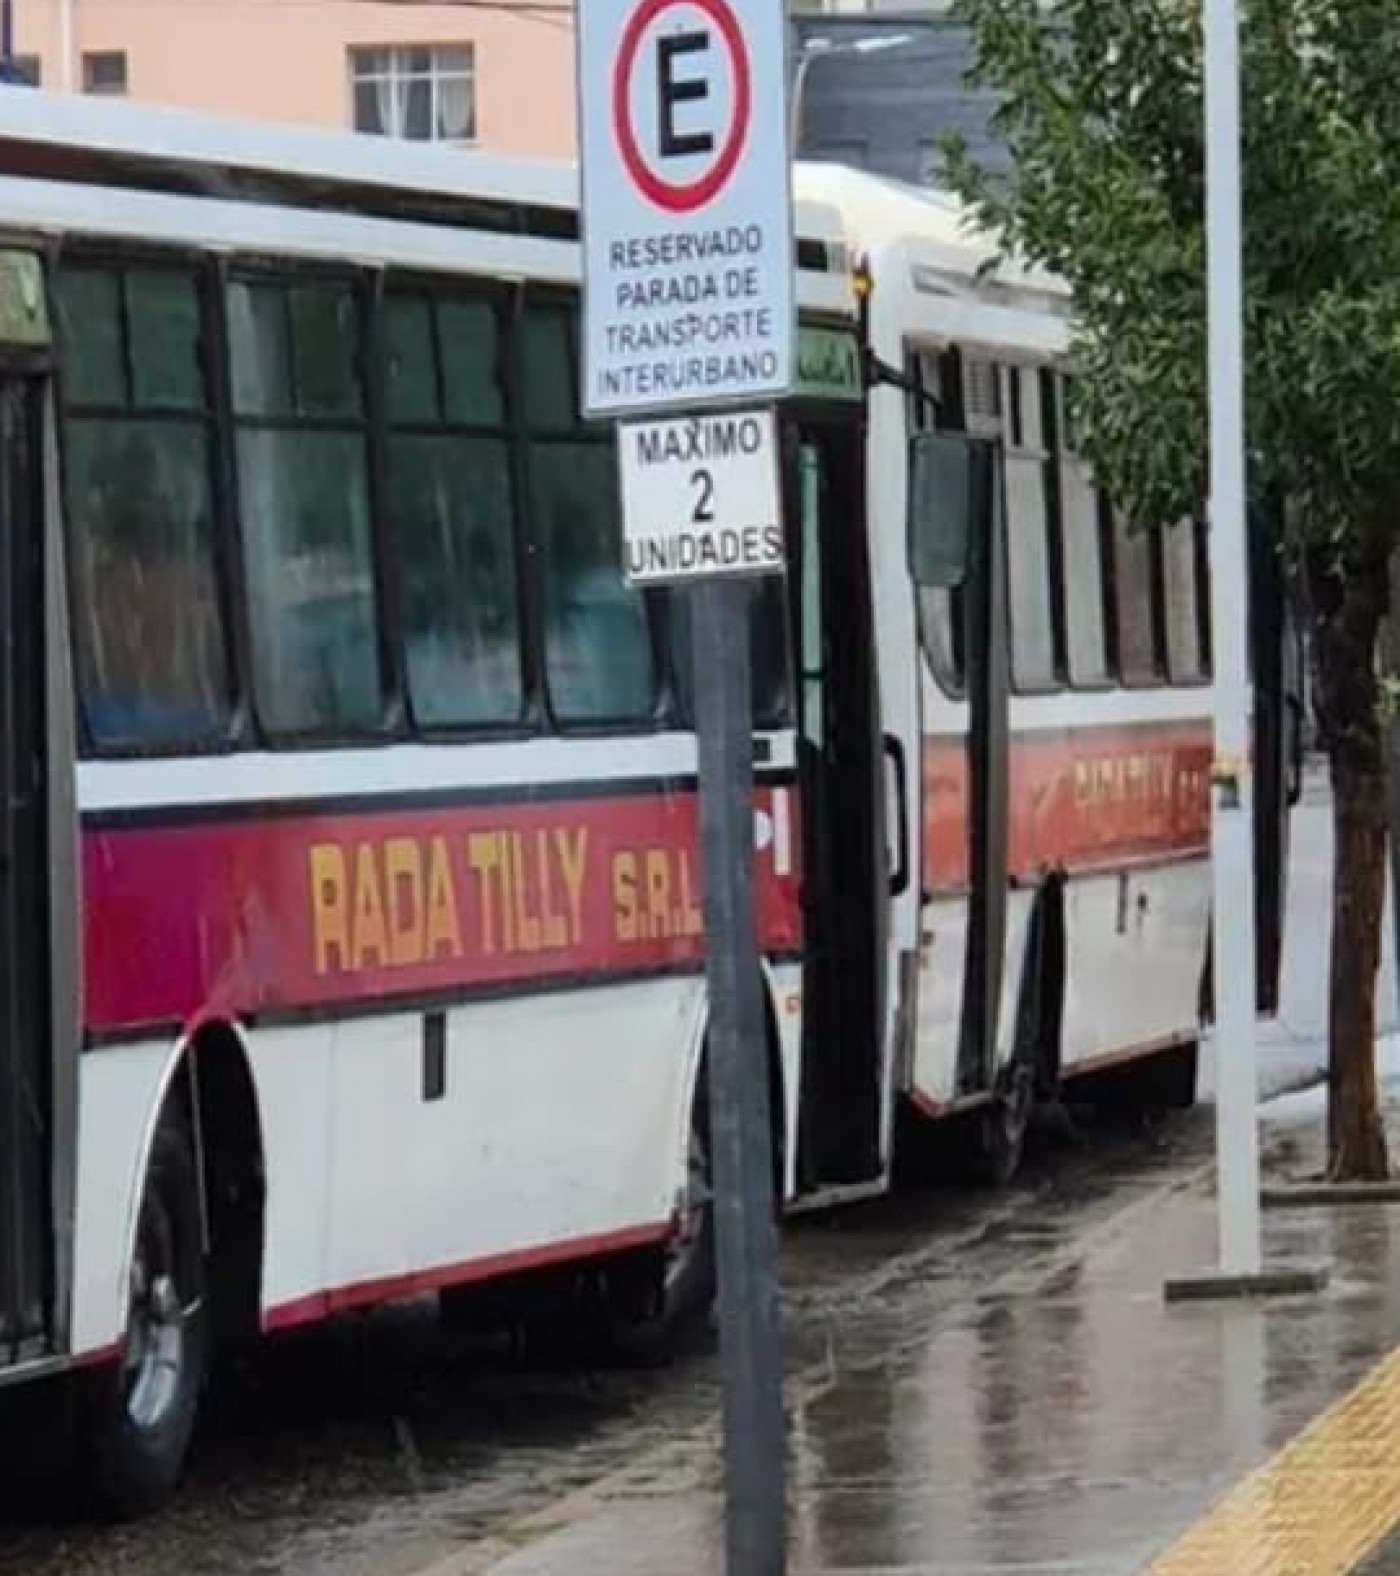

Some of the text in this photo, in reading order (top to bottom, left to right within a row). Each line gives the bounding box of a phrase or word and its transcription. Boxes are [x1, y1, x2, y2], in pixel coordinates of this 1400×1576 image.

[656, 31, 714, 158] E
[609, 224, 762, 270] RESERVADO
[615, 268, 760, 309] PARADA DE
[605, 308, 772, 354] TRANSPORTE
[598, 350, 779, 397] INTERURBANO
[636, 418, 761, 466] MAXIMO
[691, 469, 715, 523] 2
[626, 525, 784, 574] UNIDADES
[309, 835, 463, 976] RADA
[467, 827, 588, 954] TILLY
